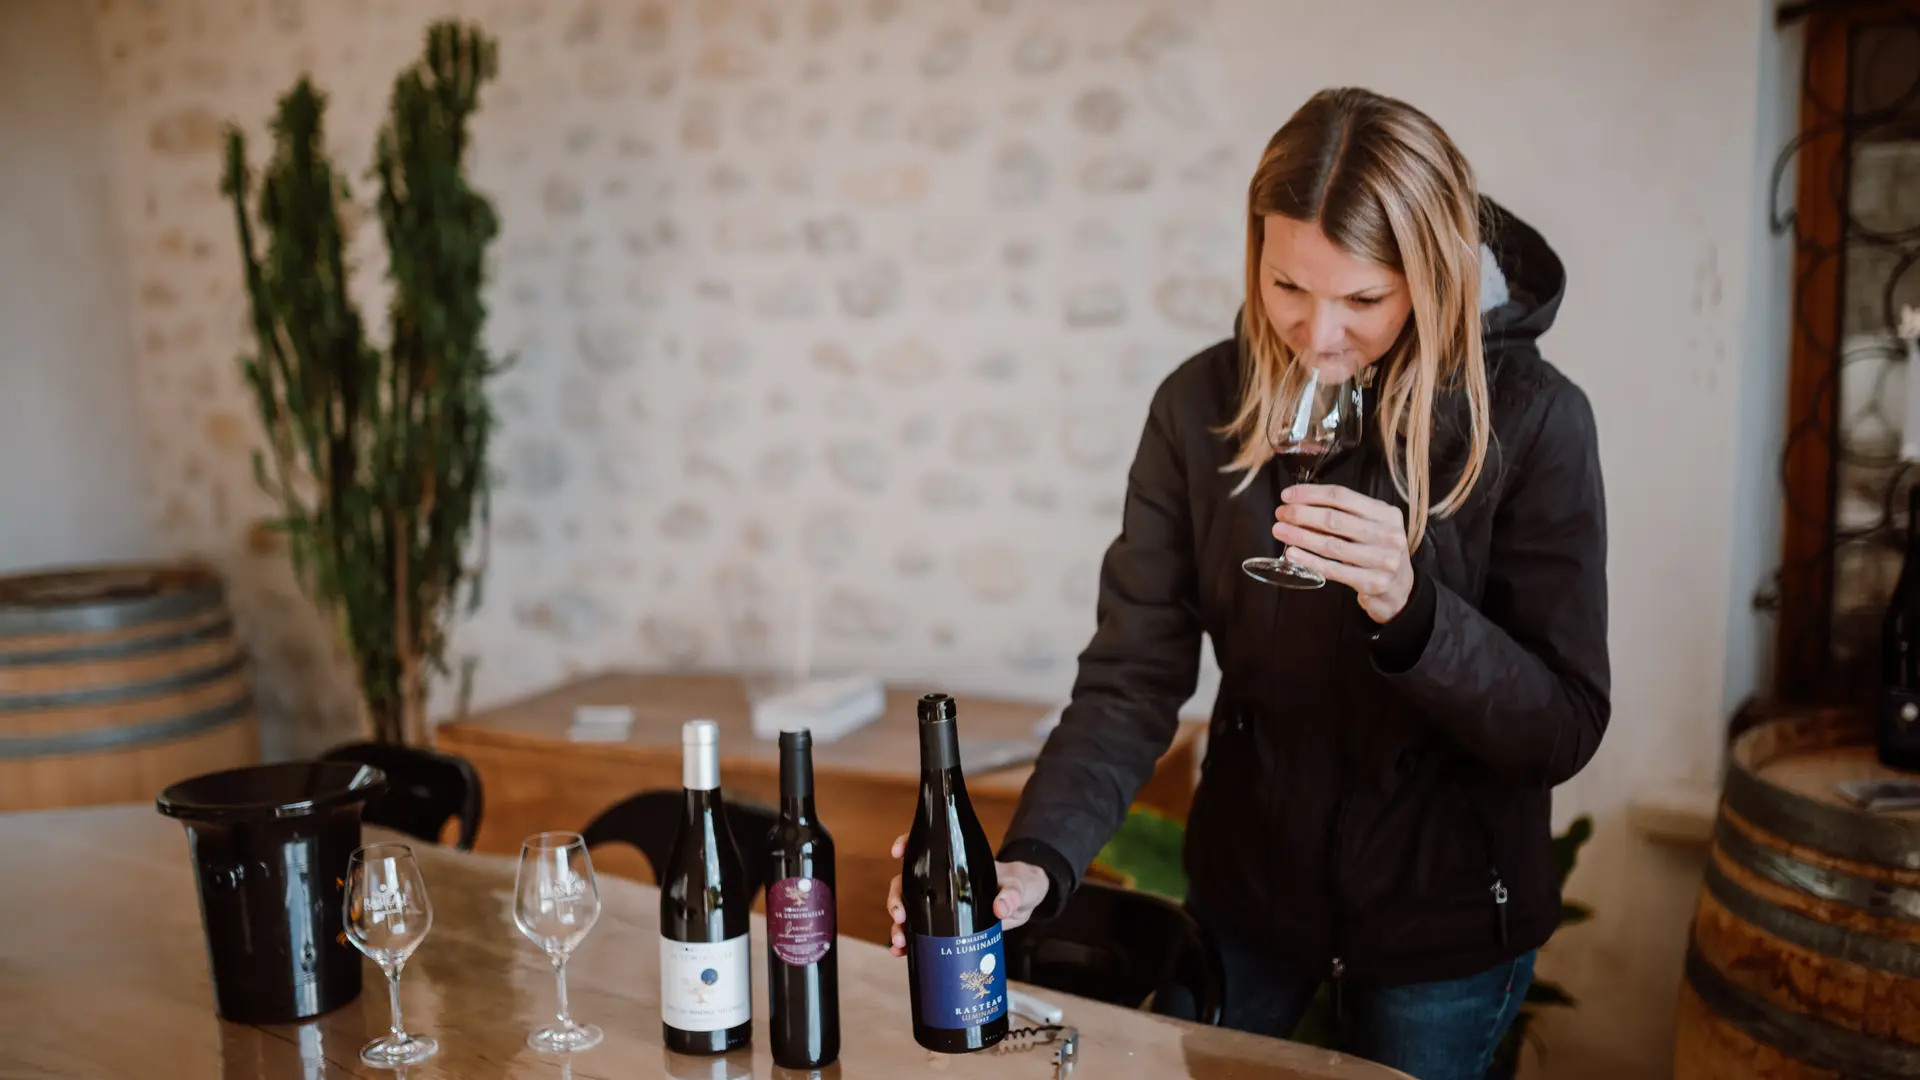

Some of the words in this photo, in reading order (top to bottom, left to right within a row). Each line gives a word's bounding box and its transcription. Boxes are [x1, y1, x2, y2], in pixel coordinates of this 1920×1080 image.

[941, 947, 952, 956] LA
[956, 931, 1002, 955] LUMINAILLE
[955, 932, 988, 946] DOMAINE
[955, 994, 1003, 1016] RASTEAU
[961, 1005, 999, 1022] LUMINARIS
